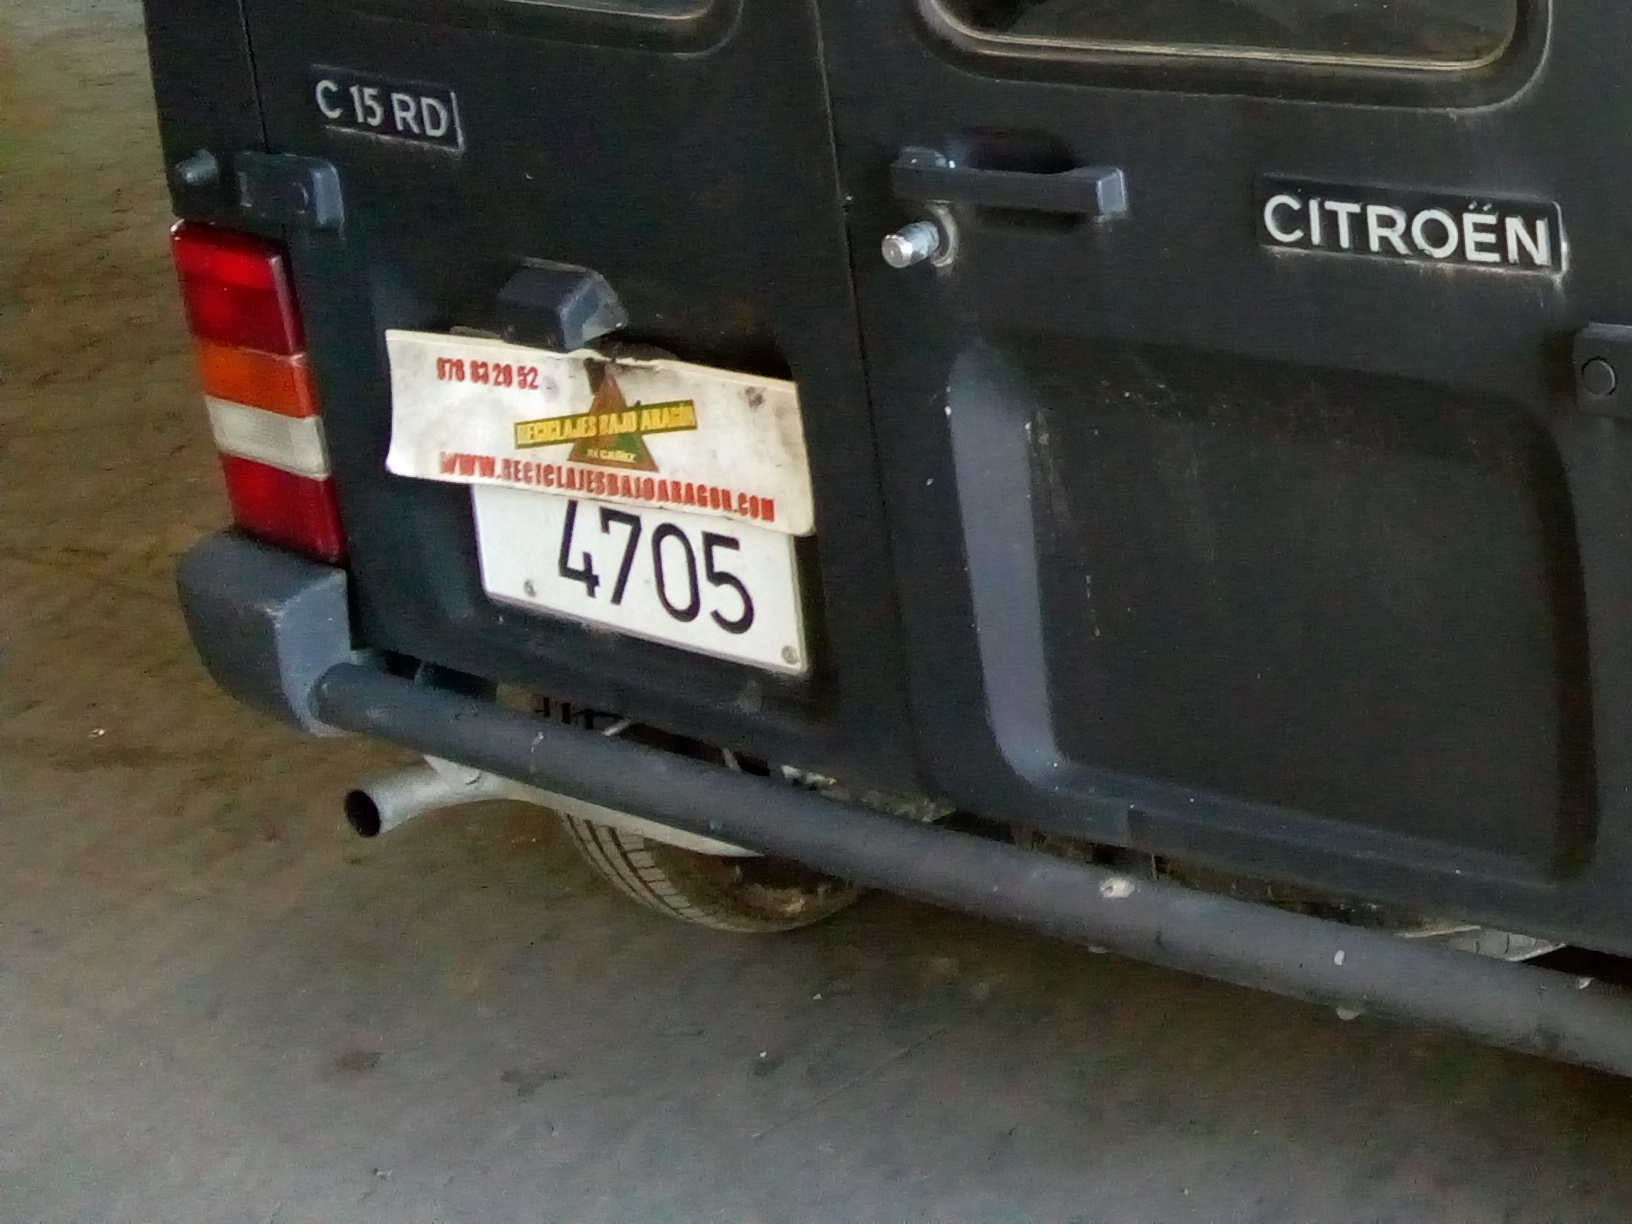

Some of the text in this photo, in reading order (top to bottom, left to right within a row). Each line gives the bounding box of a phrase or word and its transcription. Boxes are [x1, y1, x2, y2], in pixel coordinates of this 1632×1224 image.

[315, 79, 449, 137] C 15 RD
[1264, 193, 1552, 266] CITROËN
[517, 365, 539, 390] 52
[558, 499, 755, 635] 4705
